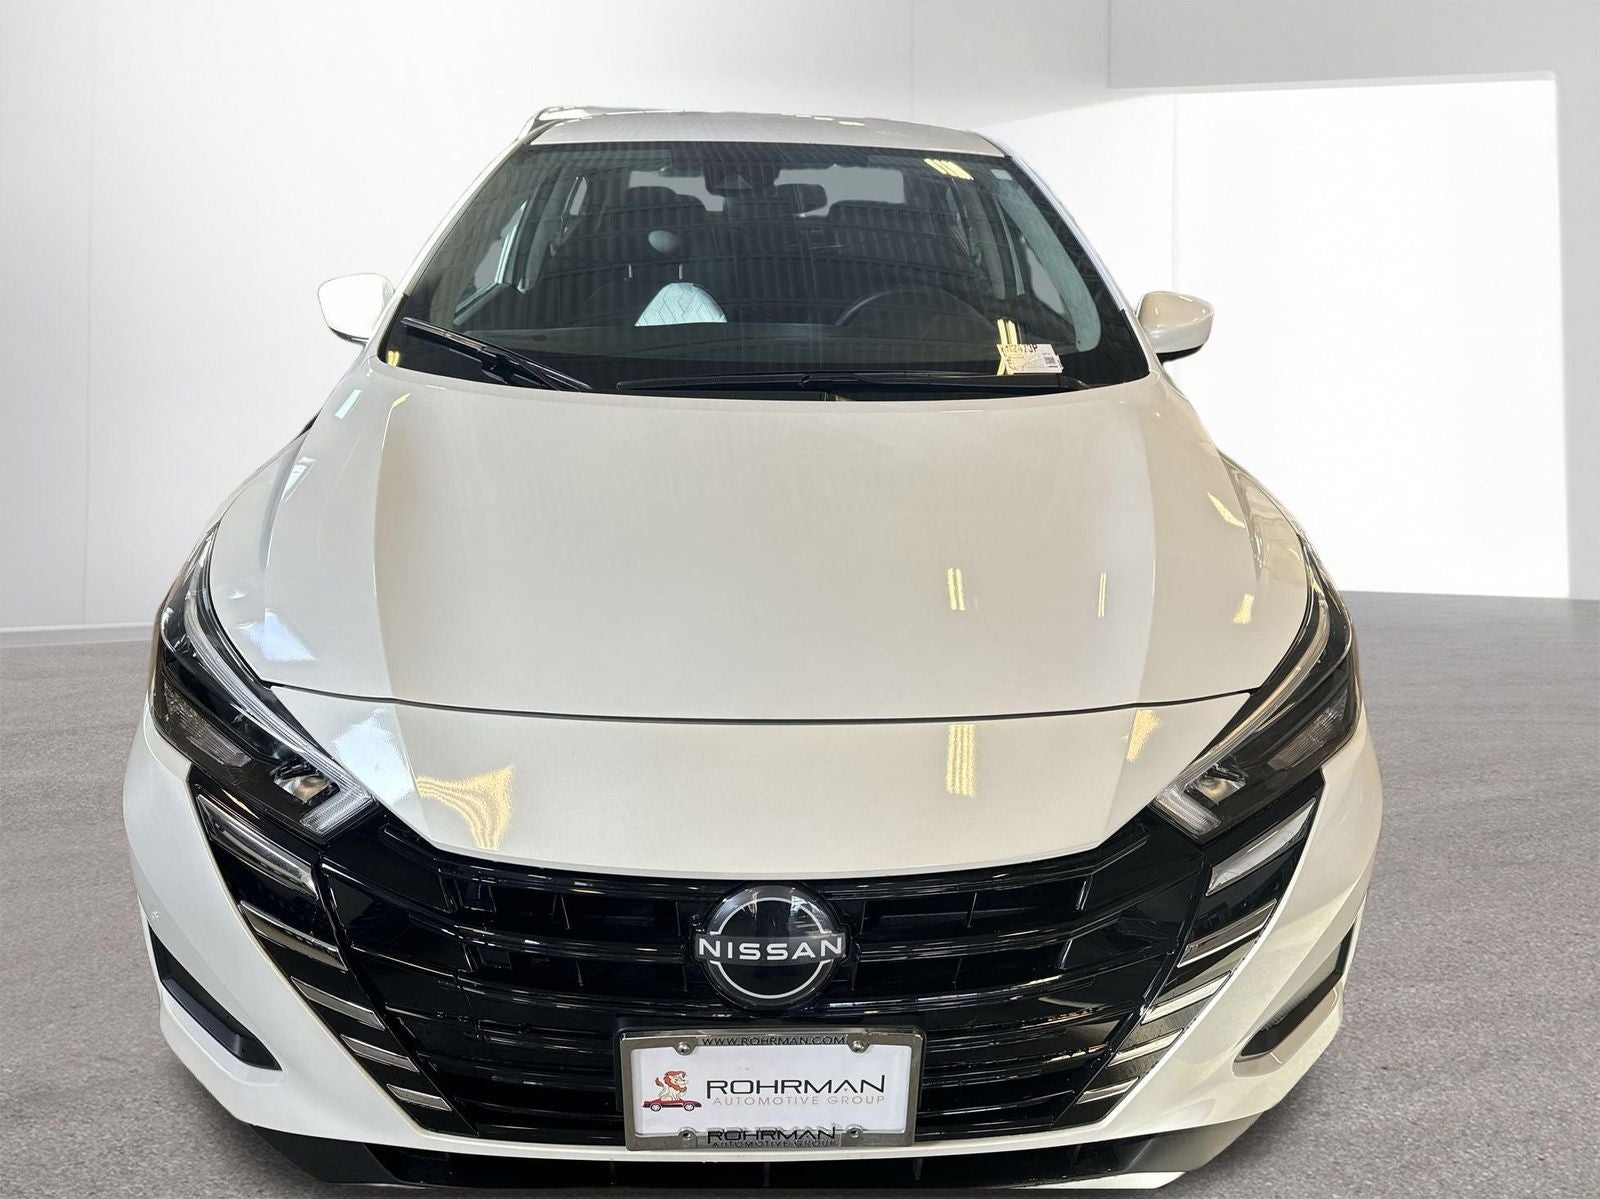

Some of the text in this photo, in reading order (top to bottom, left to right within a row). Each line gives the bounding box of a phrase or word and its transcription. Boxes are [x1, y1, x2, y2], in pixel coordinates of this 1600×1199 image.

[699, 937, 841, 960] NISSAN
[702, 1036, 845, 1046] WWW.ROHRMAN.COM
[706, 1075, 885, 1099] ROHRMAN
[712, 1095, 885, 1106] AUTOMOTIVE GROUP
[707, 1126, 836, 1144] ROHRMAN
[712, 1140, 789, 1148] AUTOMOTIVE
